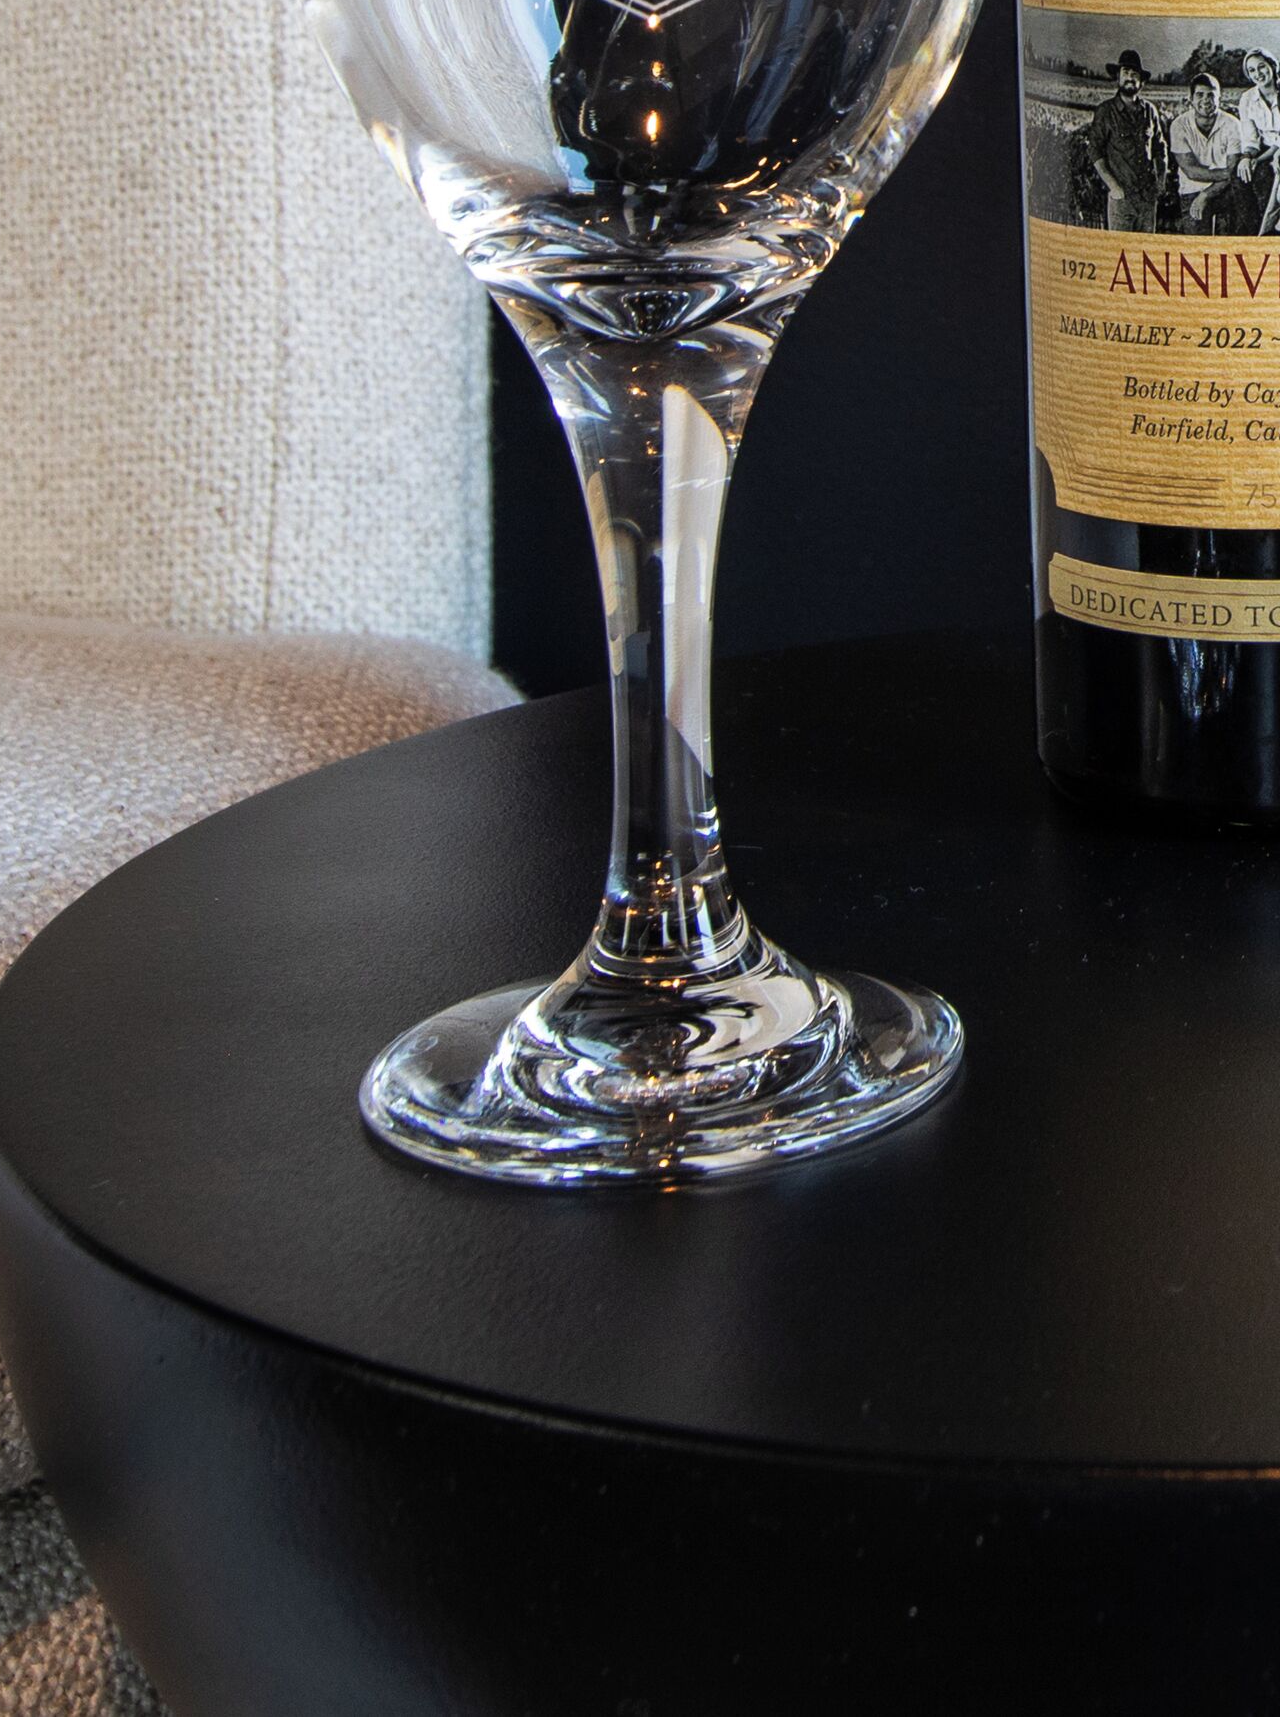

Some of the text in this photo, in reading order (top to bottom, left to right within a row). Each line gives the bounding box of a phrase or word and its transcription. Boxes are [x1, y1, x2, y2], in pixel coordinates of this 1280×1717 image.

[1061, 258, 1097, 281] 1972
[1059, 314, 1098, 340] NAPA
[1102, 321, 1176, 347] VALLEY
[1198, 326, 1263, 349] 2022
[1122, 375, 1200, 403] Bottled
[1208, 382, 1234, 408] by
[1130, 413, 1235, 445] Fairfield,
[1070, 583, 1233, 628] DEDICATED
